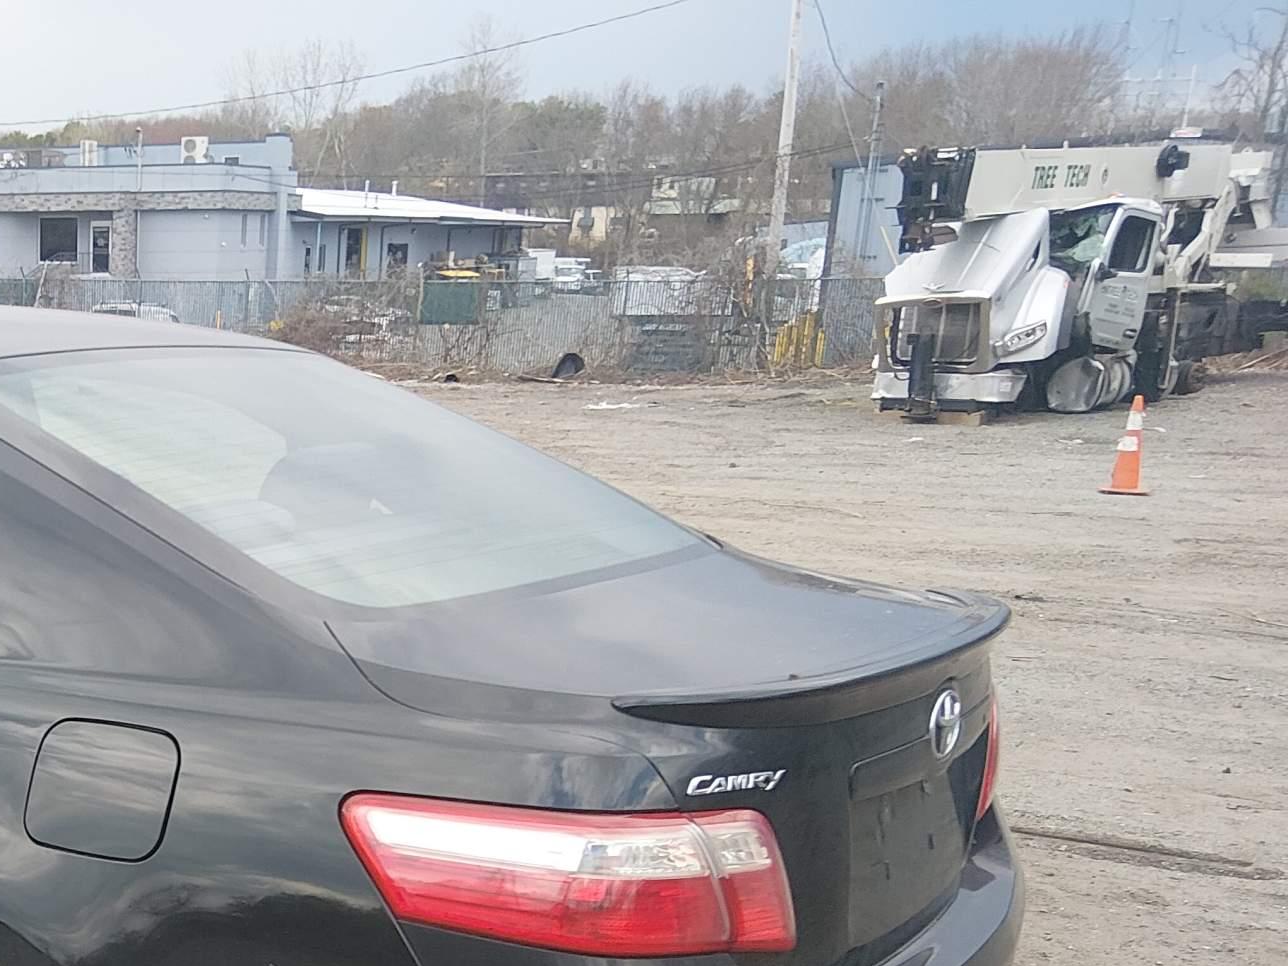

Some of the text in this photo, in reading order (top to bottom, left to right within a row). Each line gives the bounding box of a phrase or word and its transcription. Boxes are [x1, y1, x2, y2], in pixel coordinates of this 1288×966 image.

[1031, 163, 1092, 189] TREE TECH
[685, 768, 787, 796] CAMRY
